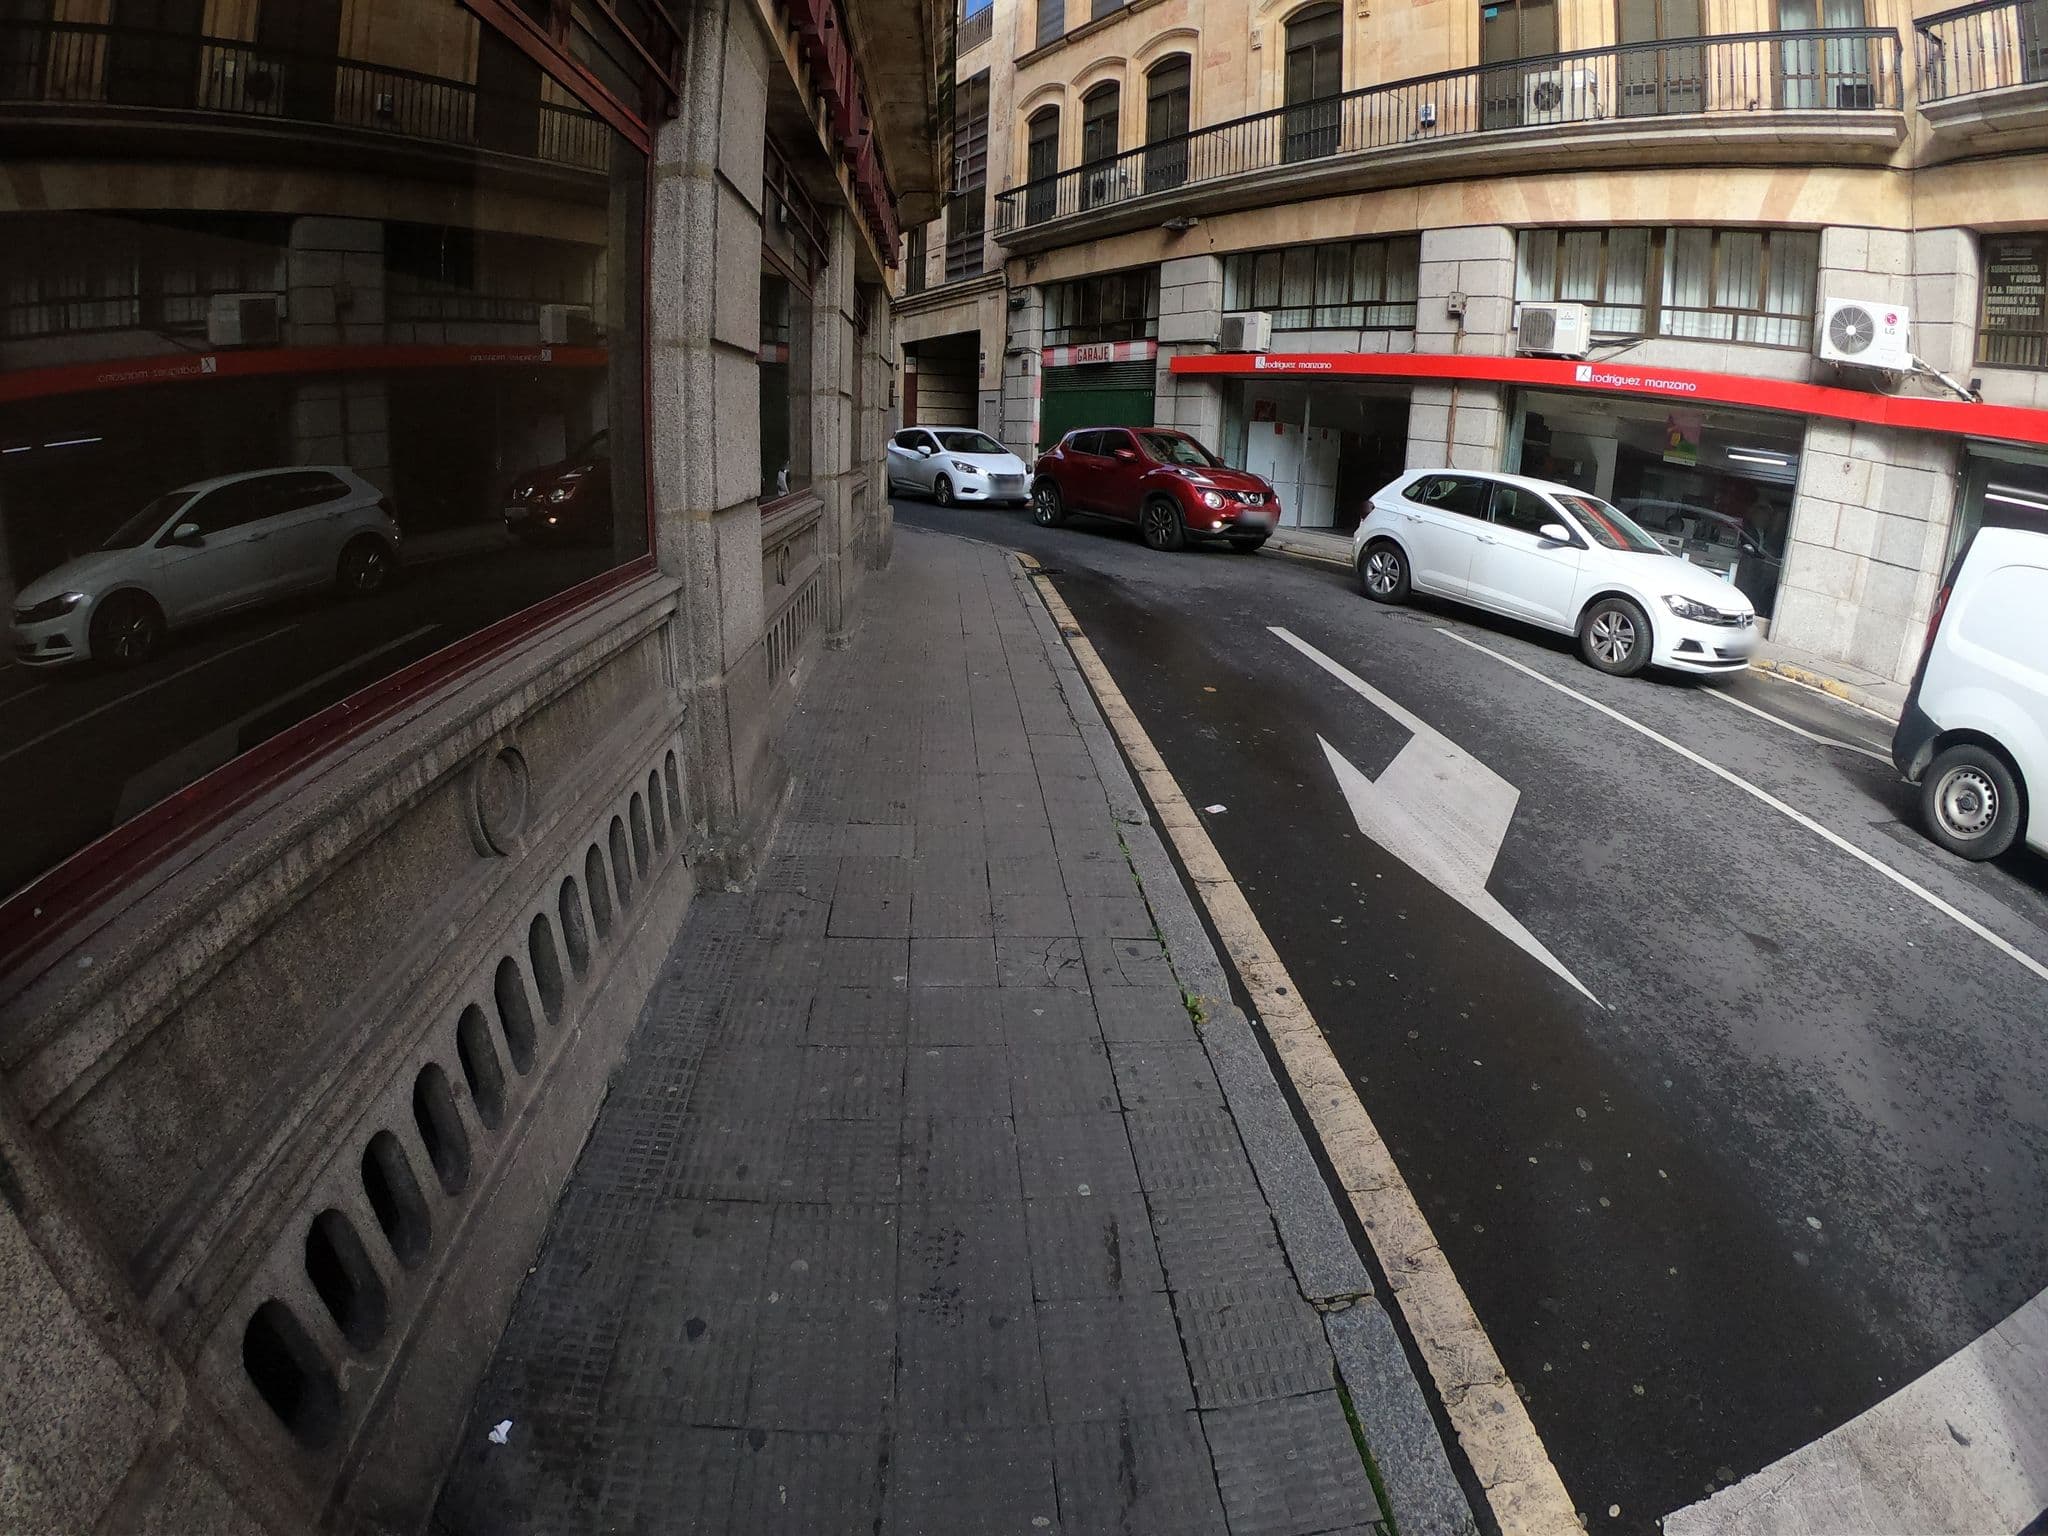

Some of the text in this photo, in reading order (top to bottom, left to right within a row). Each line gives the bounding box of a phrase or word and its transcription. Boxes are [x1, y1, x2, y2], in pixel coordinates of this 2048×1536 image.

[2016, 274, 2041, 283] AYUDAS
[1077, 346, 1109, 362] GARAJE
[1645, 378, 1696, 391] manzano
